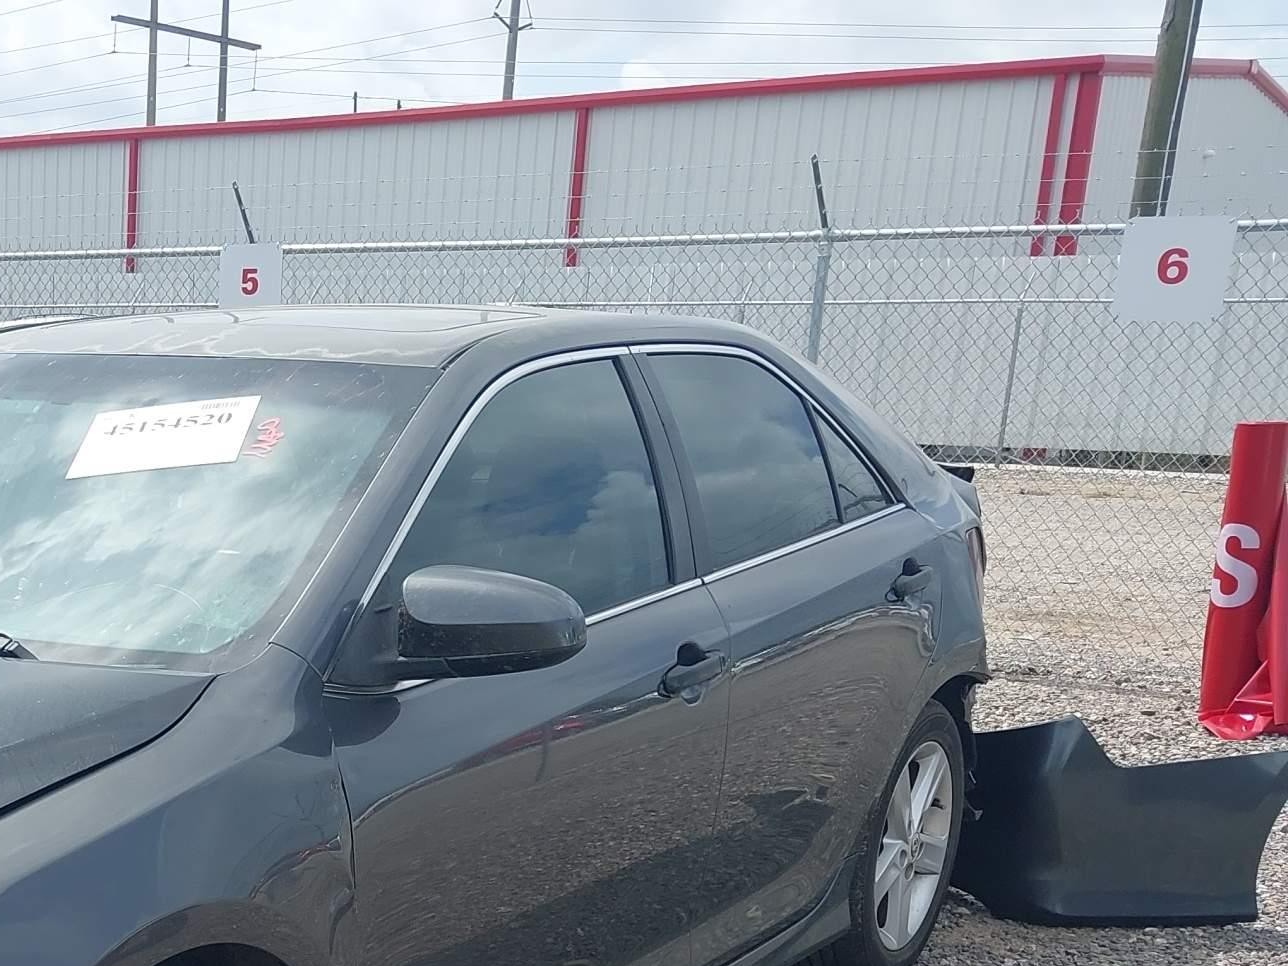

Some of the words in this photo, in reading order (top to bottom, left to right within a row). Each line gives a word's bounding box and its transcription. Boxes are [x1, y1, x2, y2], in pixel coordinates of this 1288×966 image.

[241, 268, 259, 295] 5
[1158, 248, 1188, 284] 6
[103, 412, 233, 436] 45154520
[1210, 522, 1261, 609] S
